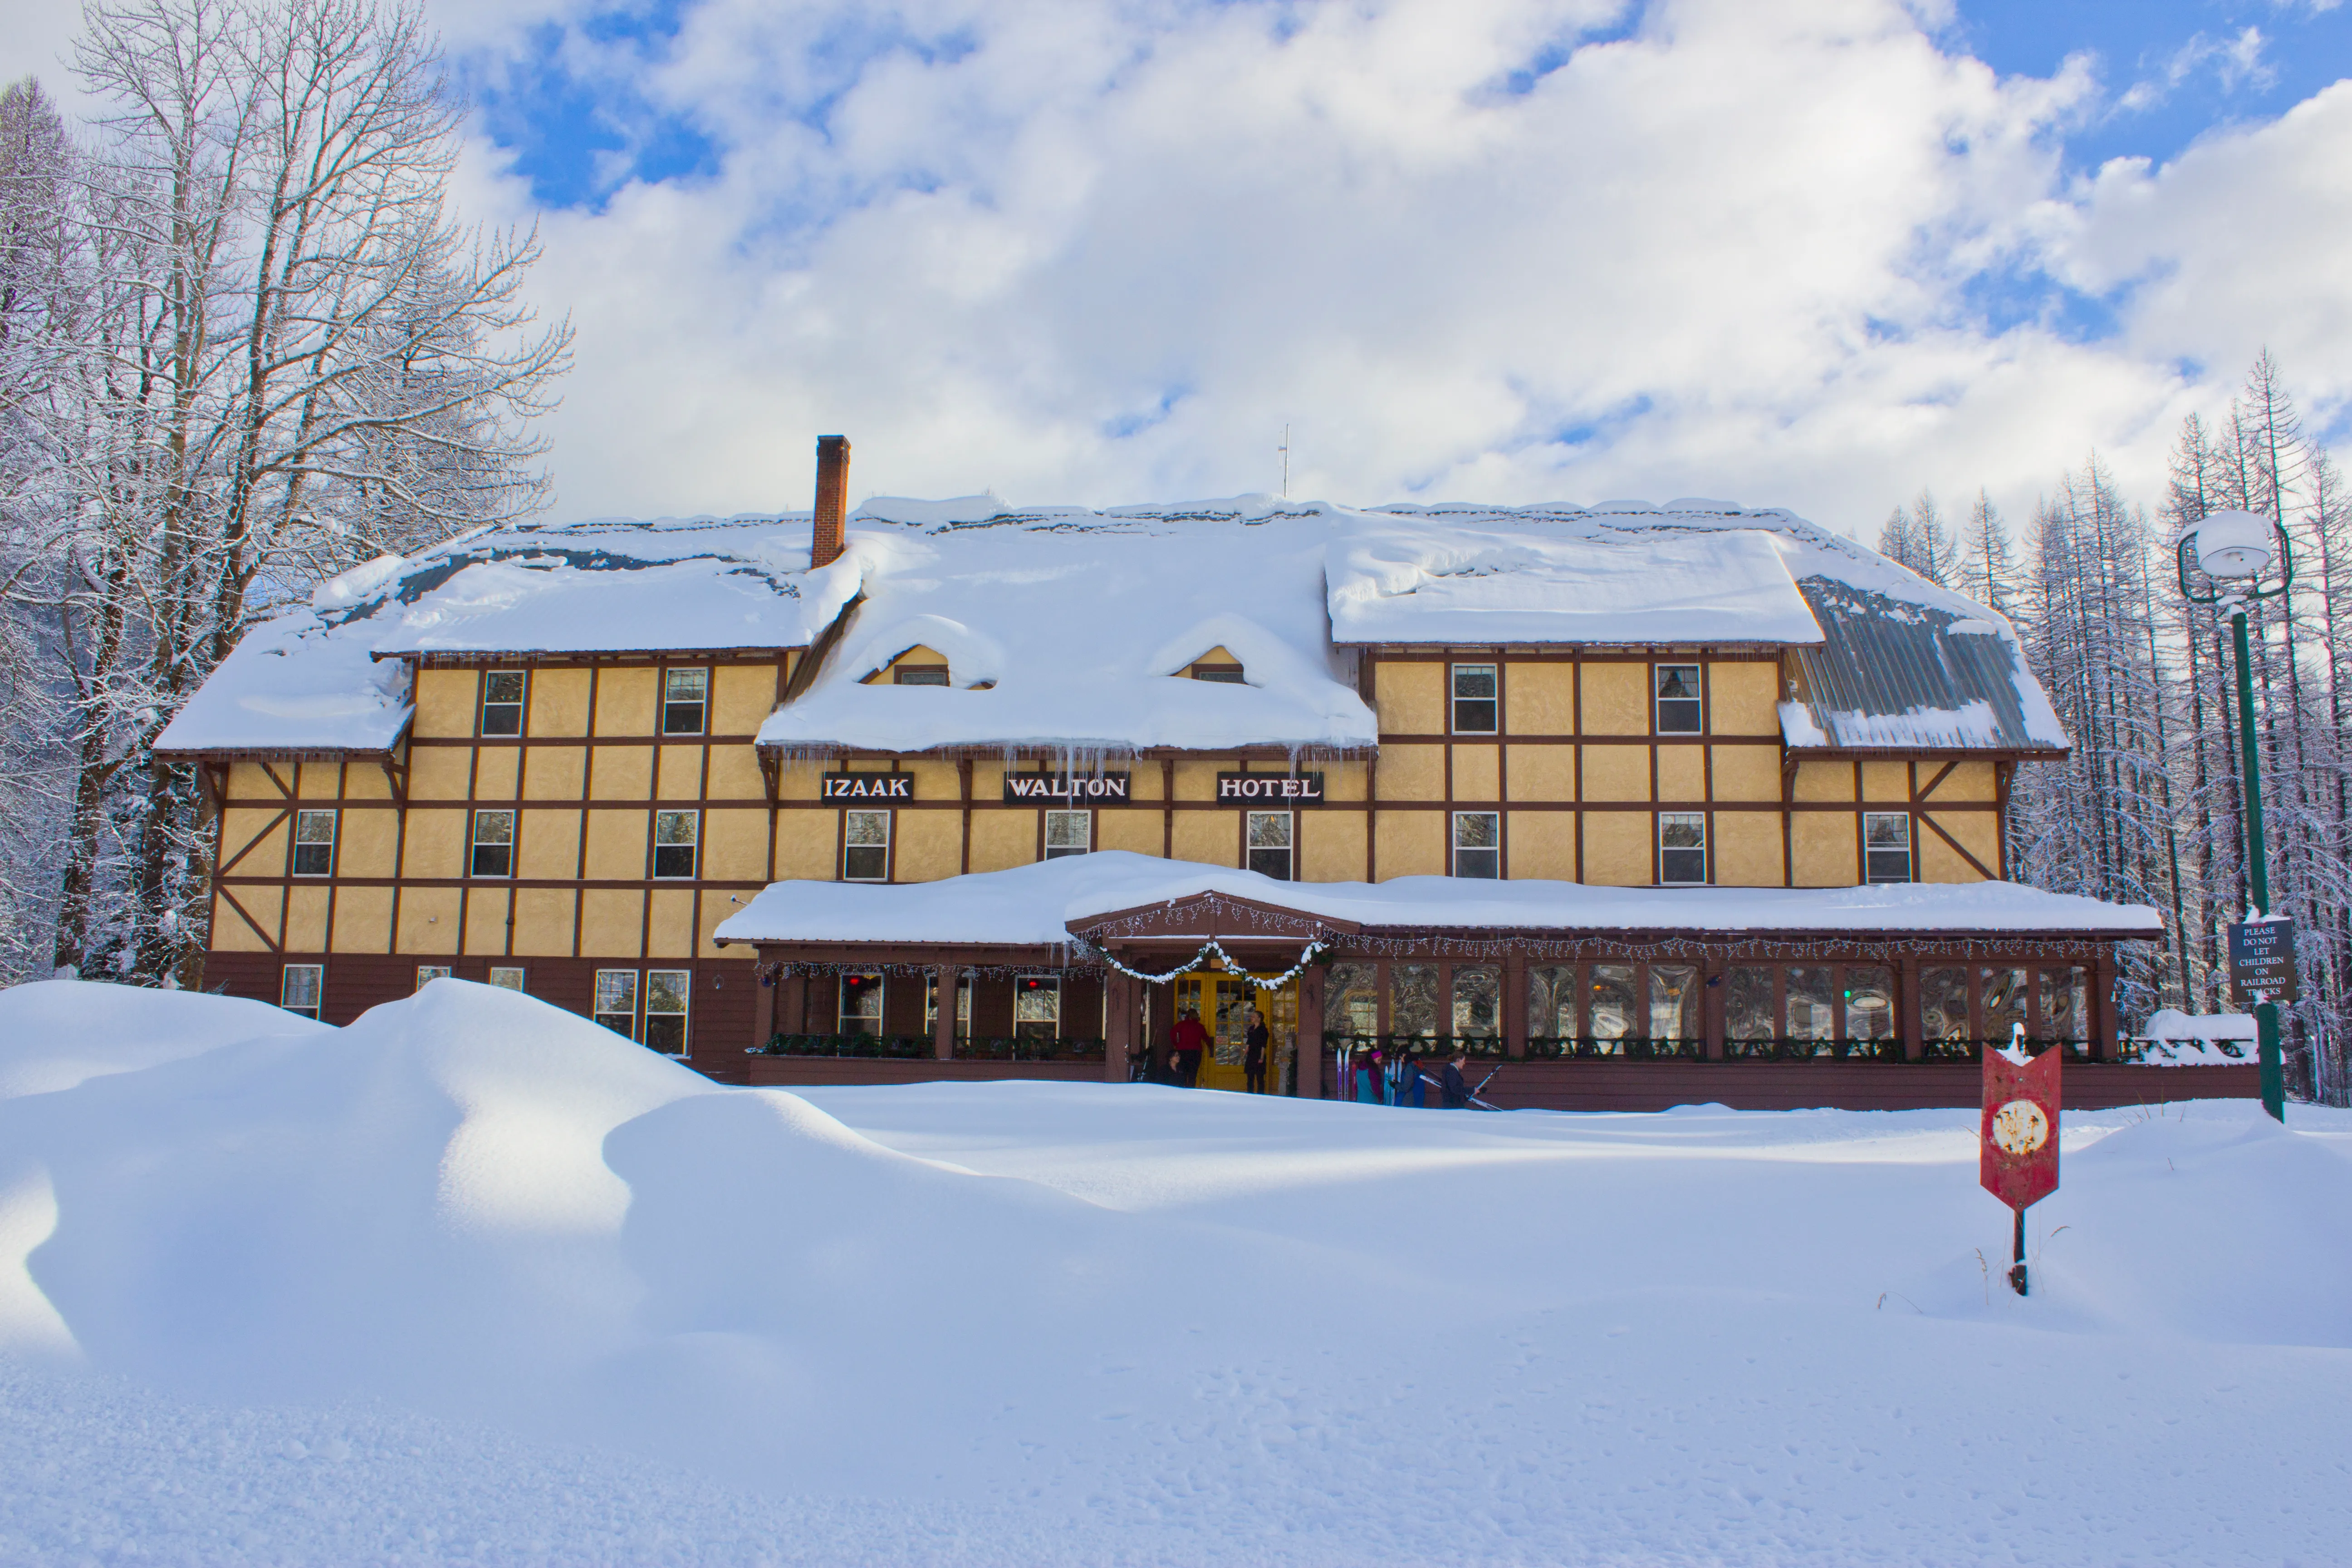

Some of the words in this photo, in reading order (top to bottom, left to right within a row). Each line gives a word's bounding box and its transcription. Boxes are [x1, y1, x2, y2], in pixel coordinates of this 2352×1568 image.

[824, 779, 909, 796] IZAAK
[1008, 779, 1126, 796] WALTON
[1220, 779, 1321, 797] HOTEL
[2244, 927, 2275, 936] PLEASE
[2258, 937, 2278, 945] NOT
[2254, 947, 2269, 956] LET
[2239, 956, 2284, 966] CHILDREN
[2240, 977, 2286, 986] RAILROAD
